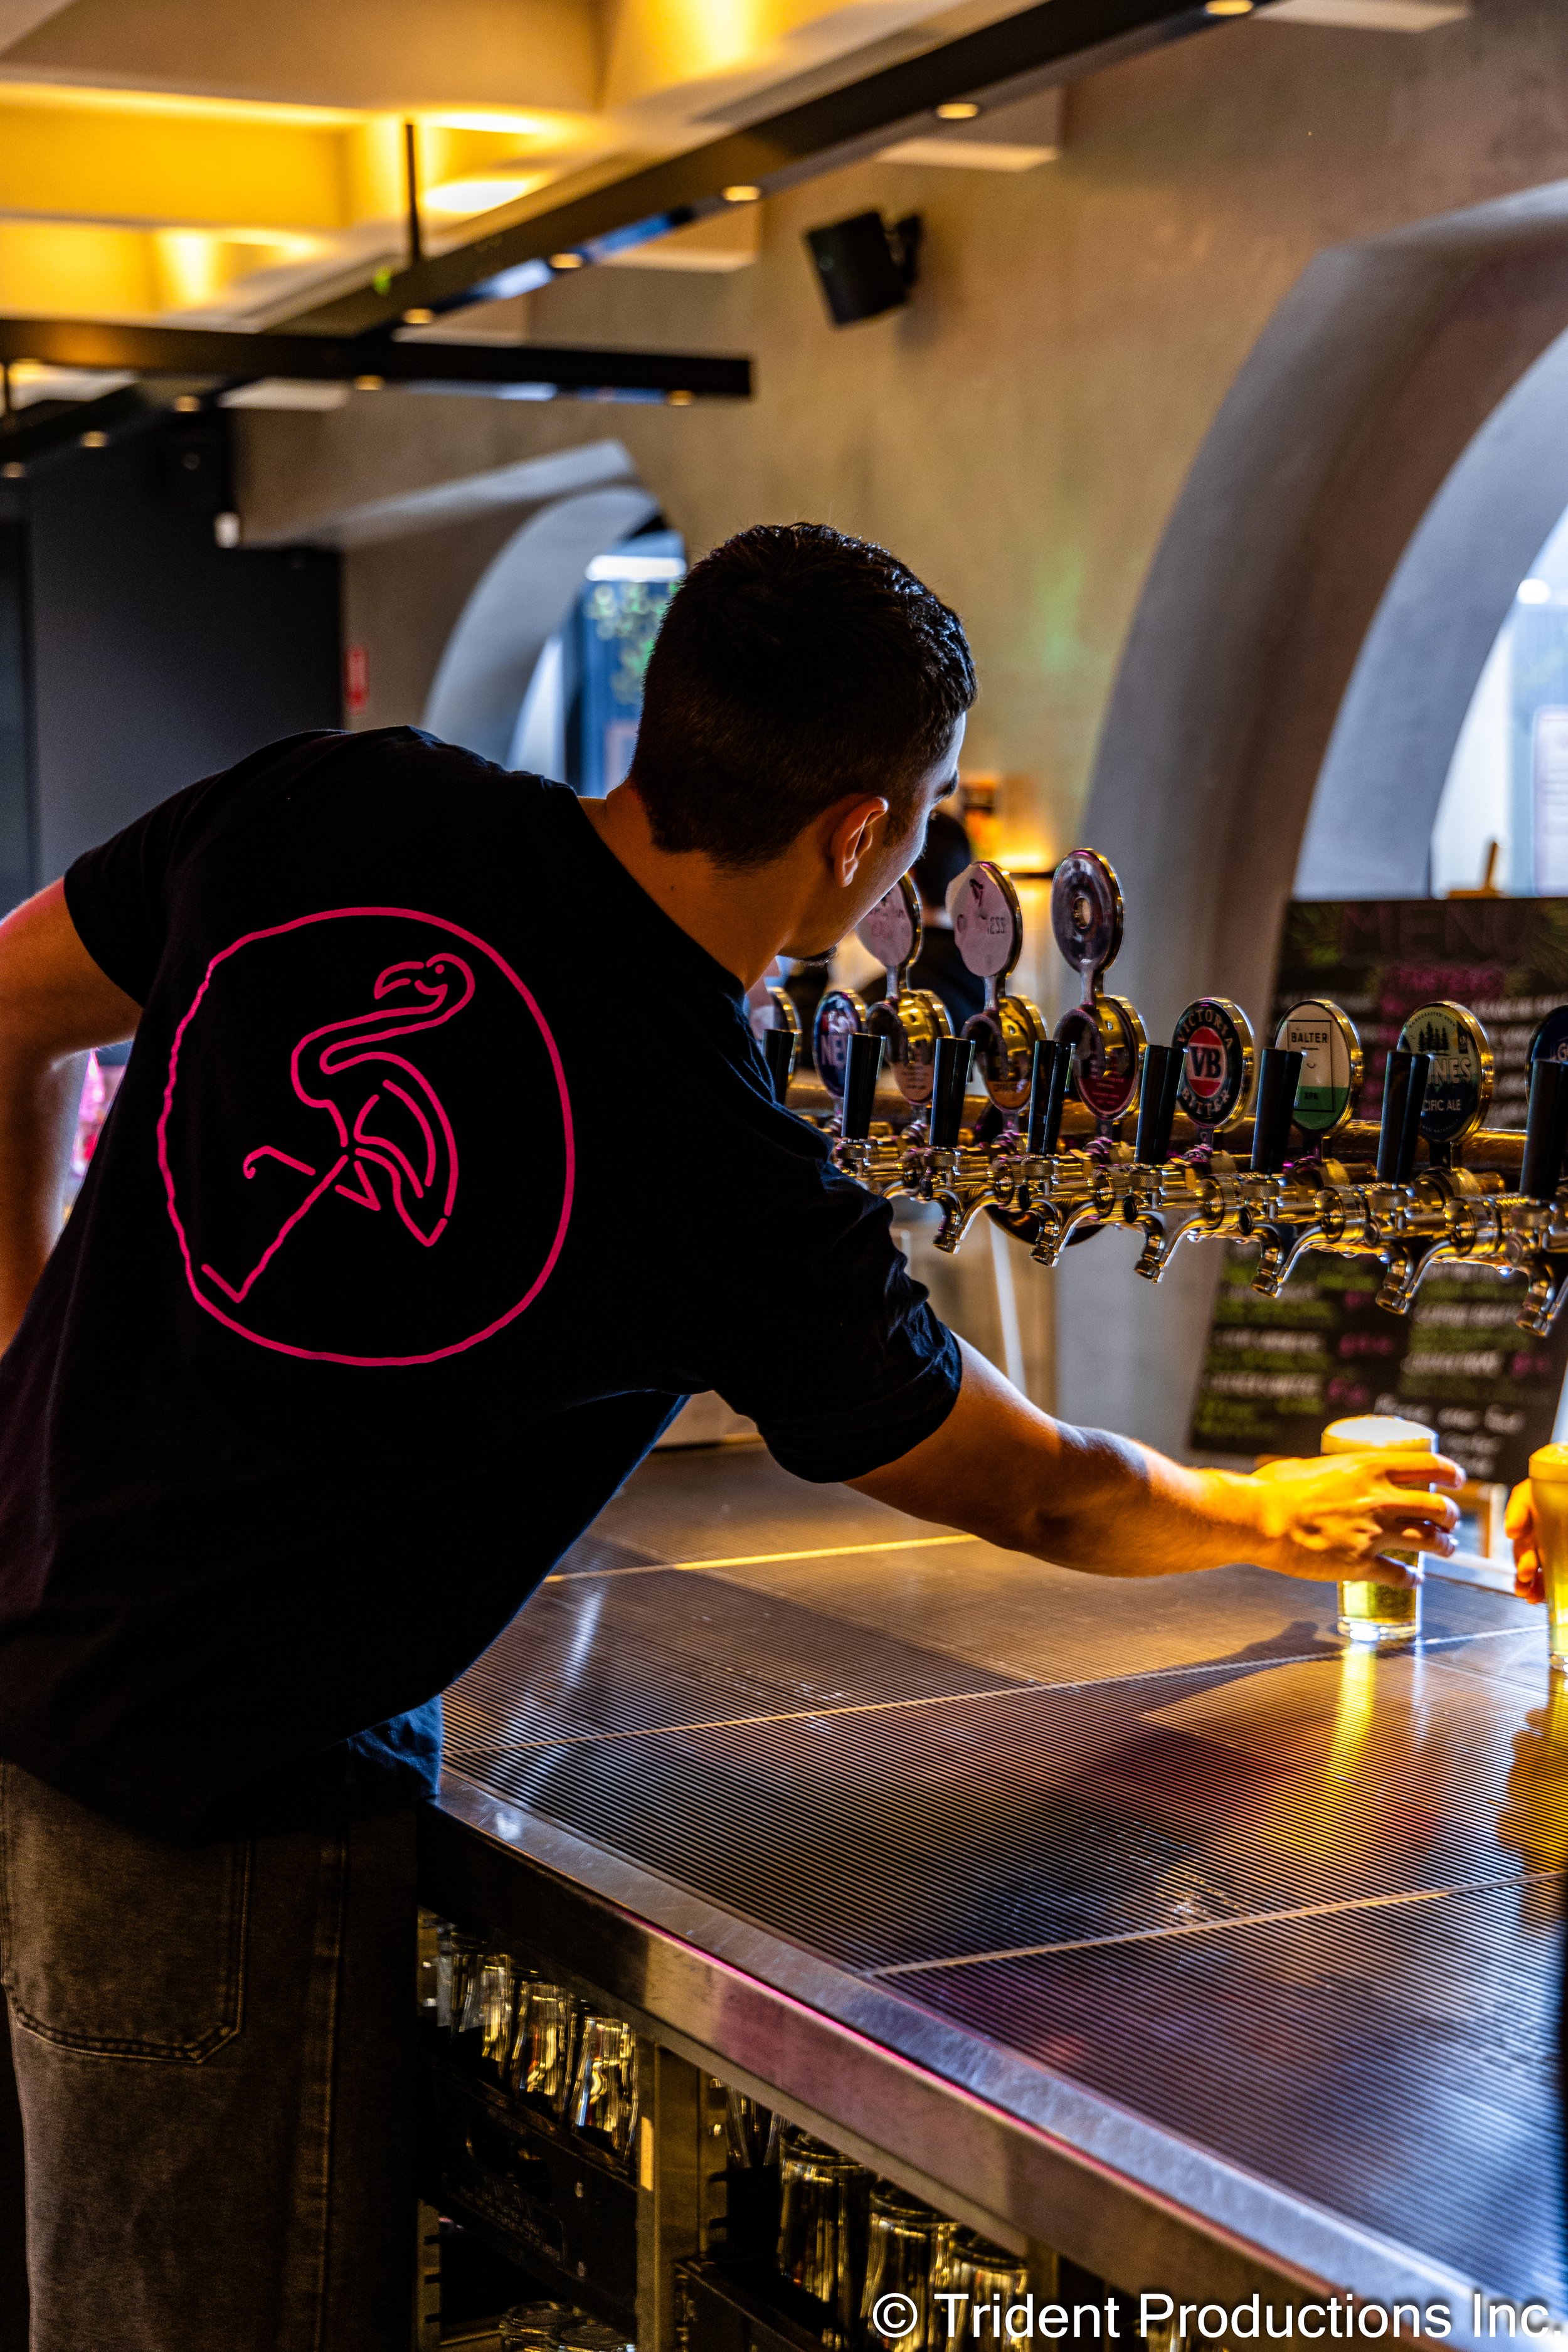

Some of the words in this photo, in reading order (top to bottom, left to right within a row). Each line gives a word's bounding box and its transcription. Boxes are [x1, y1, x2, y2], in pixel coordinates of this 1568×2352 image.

[1177, 1009, 1234, 1049] VICTORIA
[1291, 1032, 1327, 1043] BALTER
[1190, 1046, 1221, 1078] VB
[1426, 1057, 1471, 1084] INES
[1181, 1086, 1230, 1116] BITTER
[1422, 1099, 1445, 1111] CIFIC
[1446, 1099, 1461, 1111] ALE
